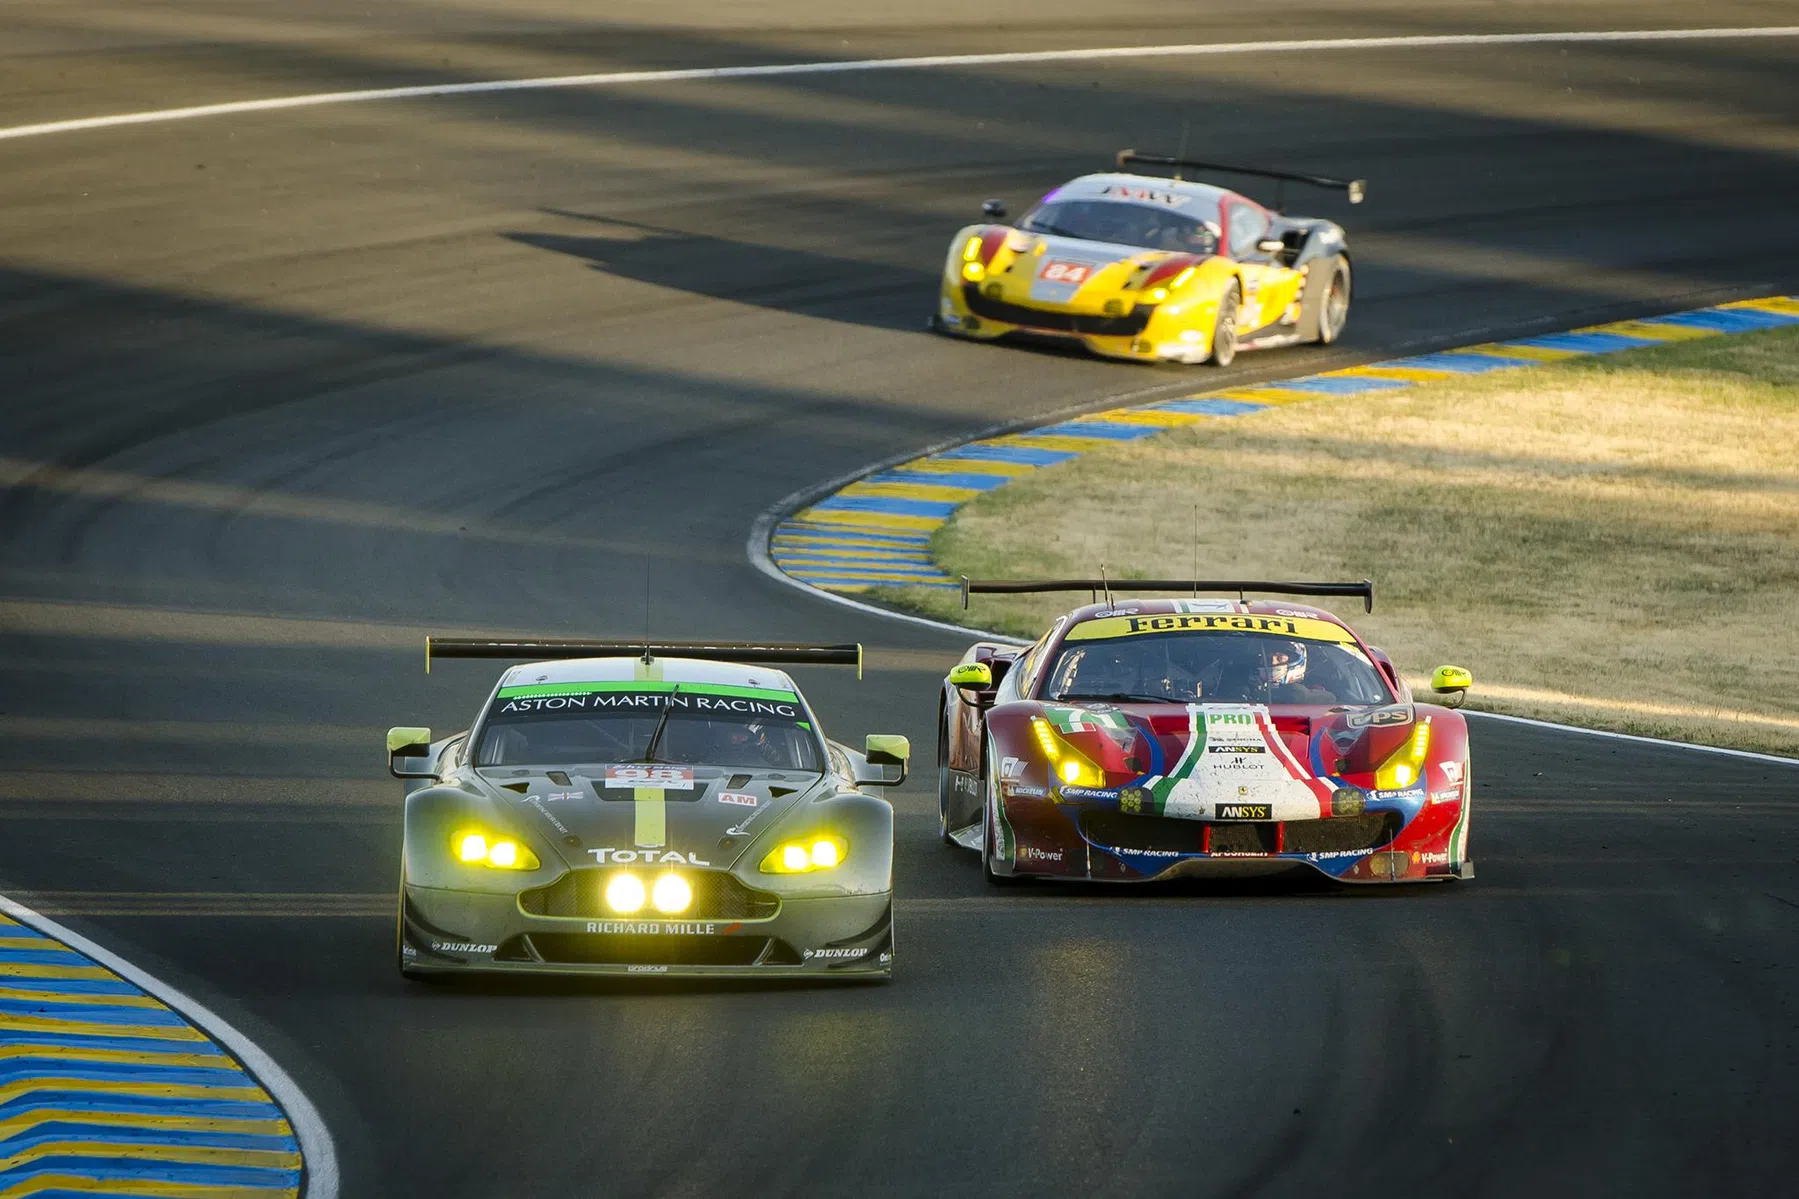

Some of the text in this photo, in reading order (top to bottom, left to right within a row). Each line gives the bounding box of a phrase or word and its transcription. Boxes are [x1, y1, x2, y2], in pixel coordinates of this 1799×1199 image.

[1126, 616, 1299, 634] Ferrari
[501, 695, 796, 717] ASTON MARTIN RACING
[1209, 713, 1251, 725] PRO
[614, 769, 684, 781] 98
[721, 794, 755, 805] AM
[1065, 788, 1118, 799] SMP RACING
[1378, 788, 1424, 799] SMP RACING
[1221, 806, 1267, 818] ANSYS
[587, 847, 710, 867] TOTAL
[1027, 847, 1063, 861] V-Power
[1123, 848, 1179, 858] SMP RACING
[1319, 847, 1373, 860] SMP RACING
[1421, 850, 1447, 863] V-Power
[587, 921, 715, 935] RICHARD MILLE
[441, 942, 497, 953] DUNLOP
[814, 948, 867, 958] DUNLOP
